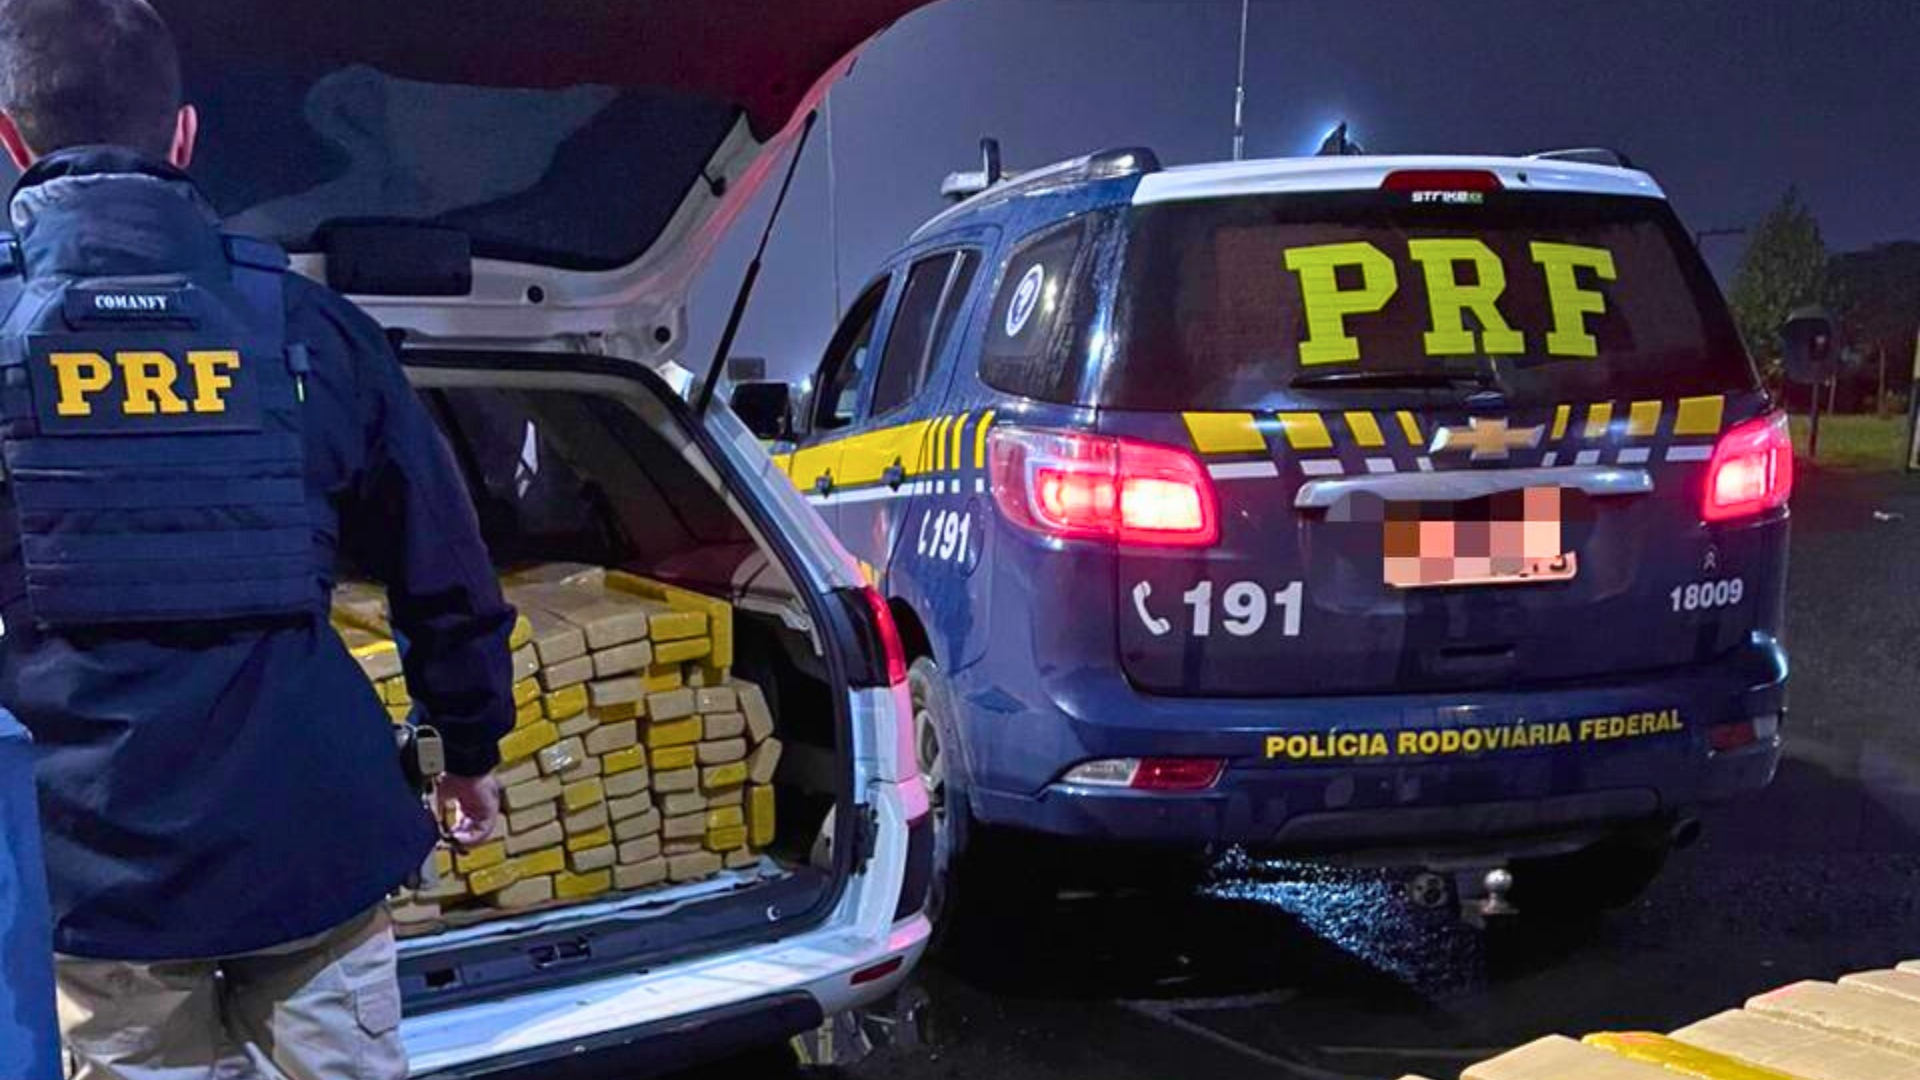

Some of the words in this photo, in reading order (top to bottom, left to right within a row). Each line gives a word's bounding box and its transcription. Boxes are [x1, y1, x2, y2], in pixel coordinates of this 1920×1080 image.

[1284, 239, 1616, 365] PRF
[50, 351, 240, 414] PRF
[929, 512, 971, 562] 191
[1184, 581, 1304, 636] 191
[1670, 578, 1743, 612] 18009
[1265, 727, 1389, 758] POLÍCIA
[1398, 718, 1572, 755] RODOVIÁRIA
[1580, 709, 1684, 741] FEDERAL
